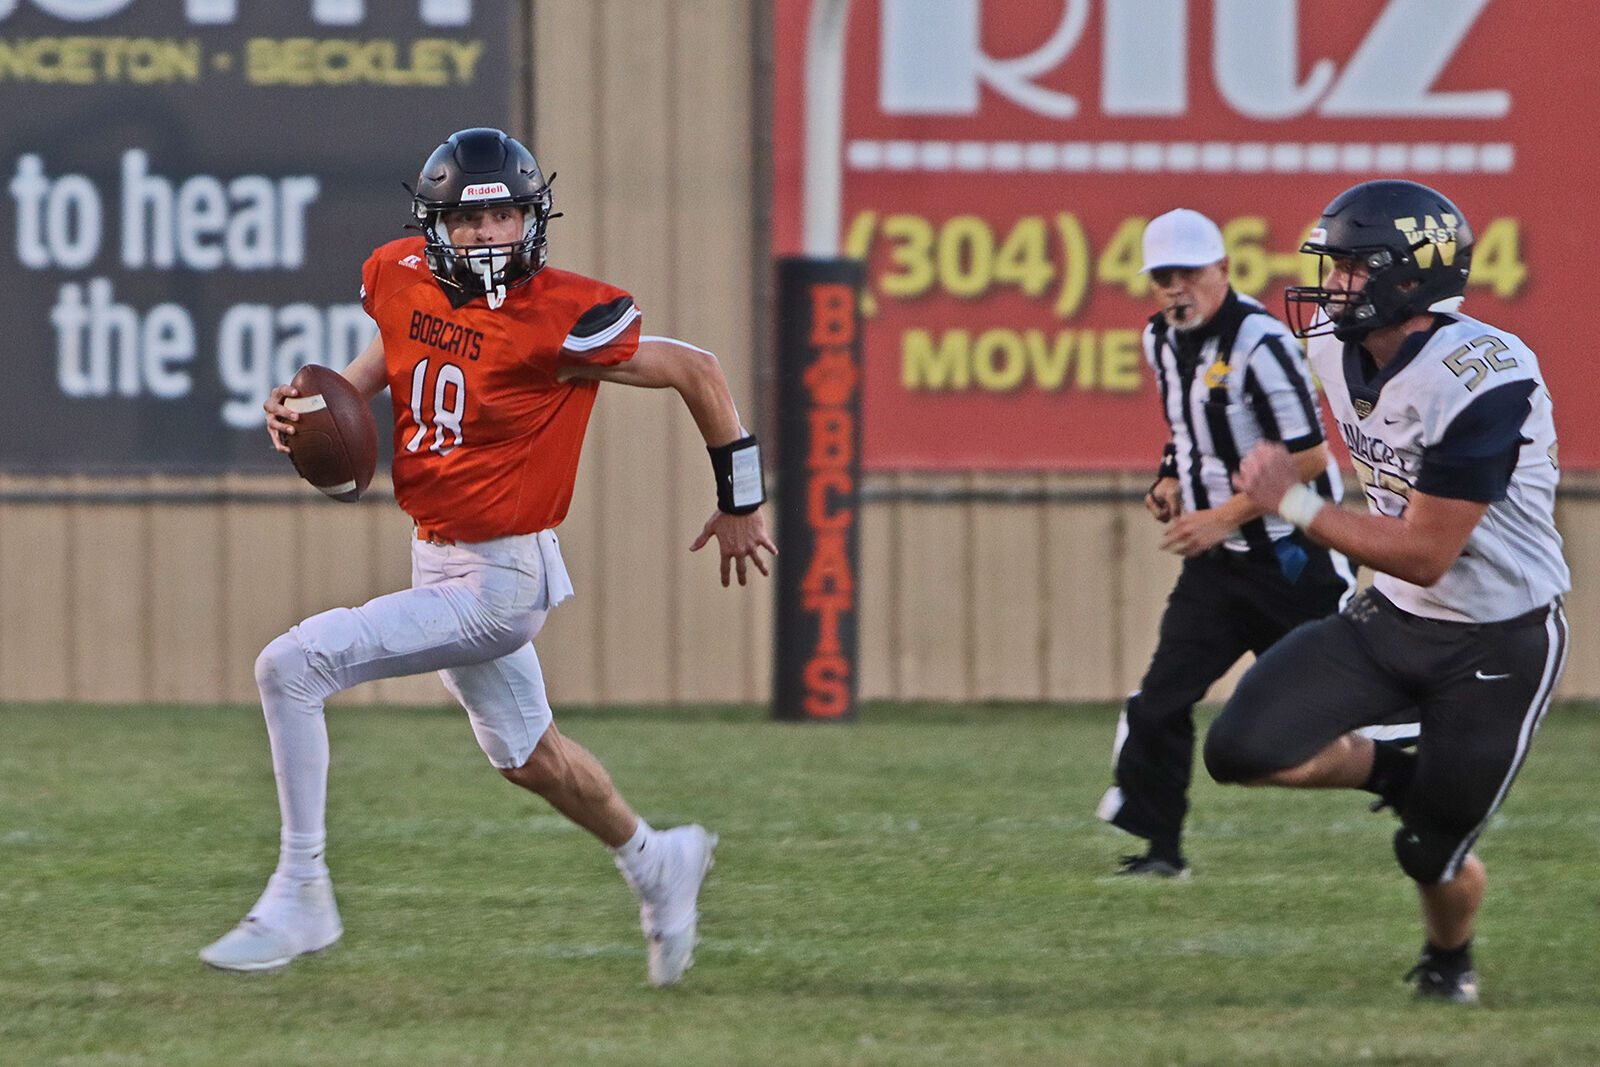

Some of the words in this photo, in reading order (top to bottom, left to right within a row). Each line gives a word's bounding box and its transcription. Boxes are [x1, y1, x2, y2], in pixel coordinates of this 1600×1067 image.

[247, 37, 484, 85] BECKLEY
[11, 153, 101, 269] to
[121, 148, 318, 269] hear
[467, 185, 503, 195] Riddell
[845, 211, 1089, 317] (304)
[51, 277, 195, 397] the
[409, 310, 484, 361] BOBCATS
[902, 328, 1143, 391] MOVIE
[1442, 335, 1518, 392] 52
[406, 357, 466, 456] 18
